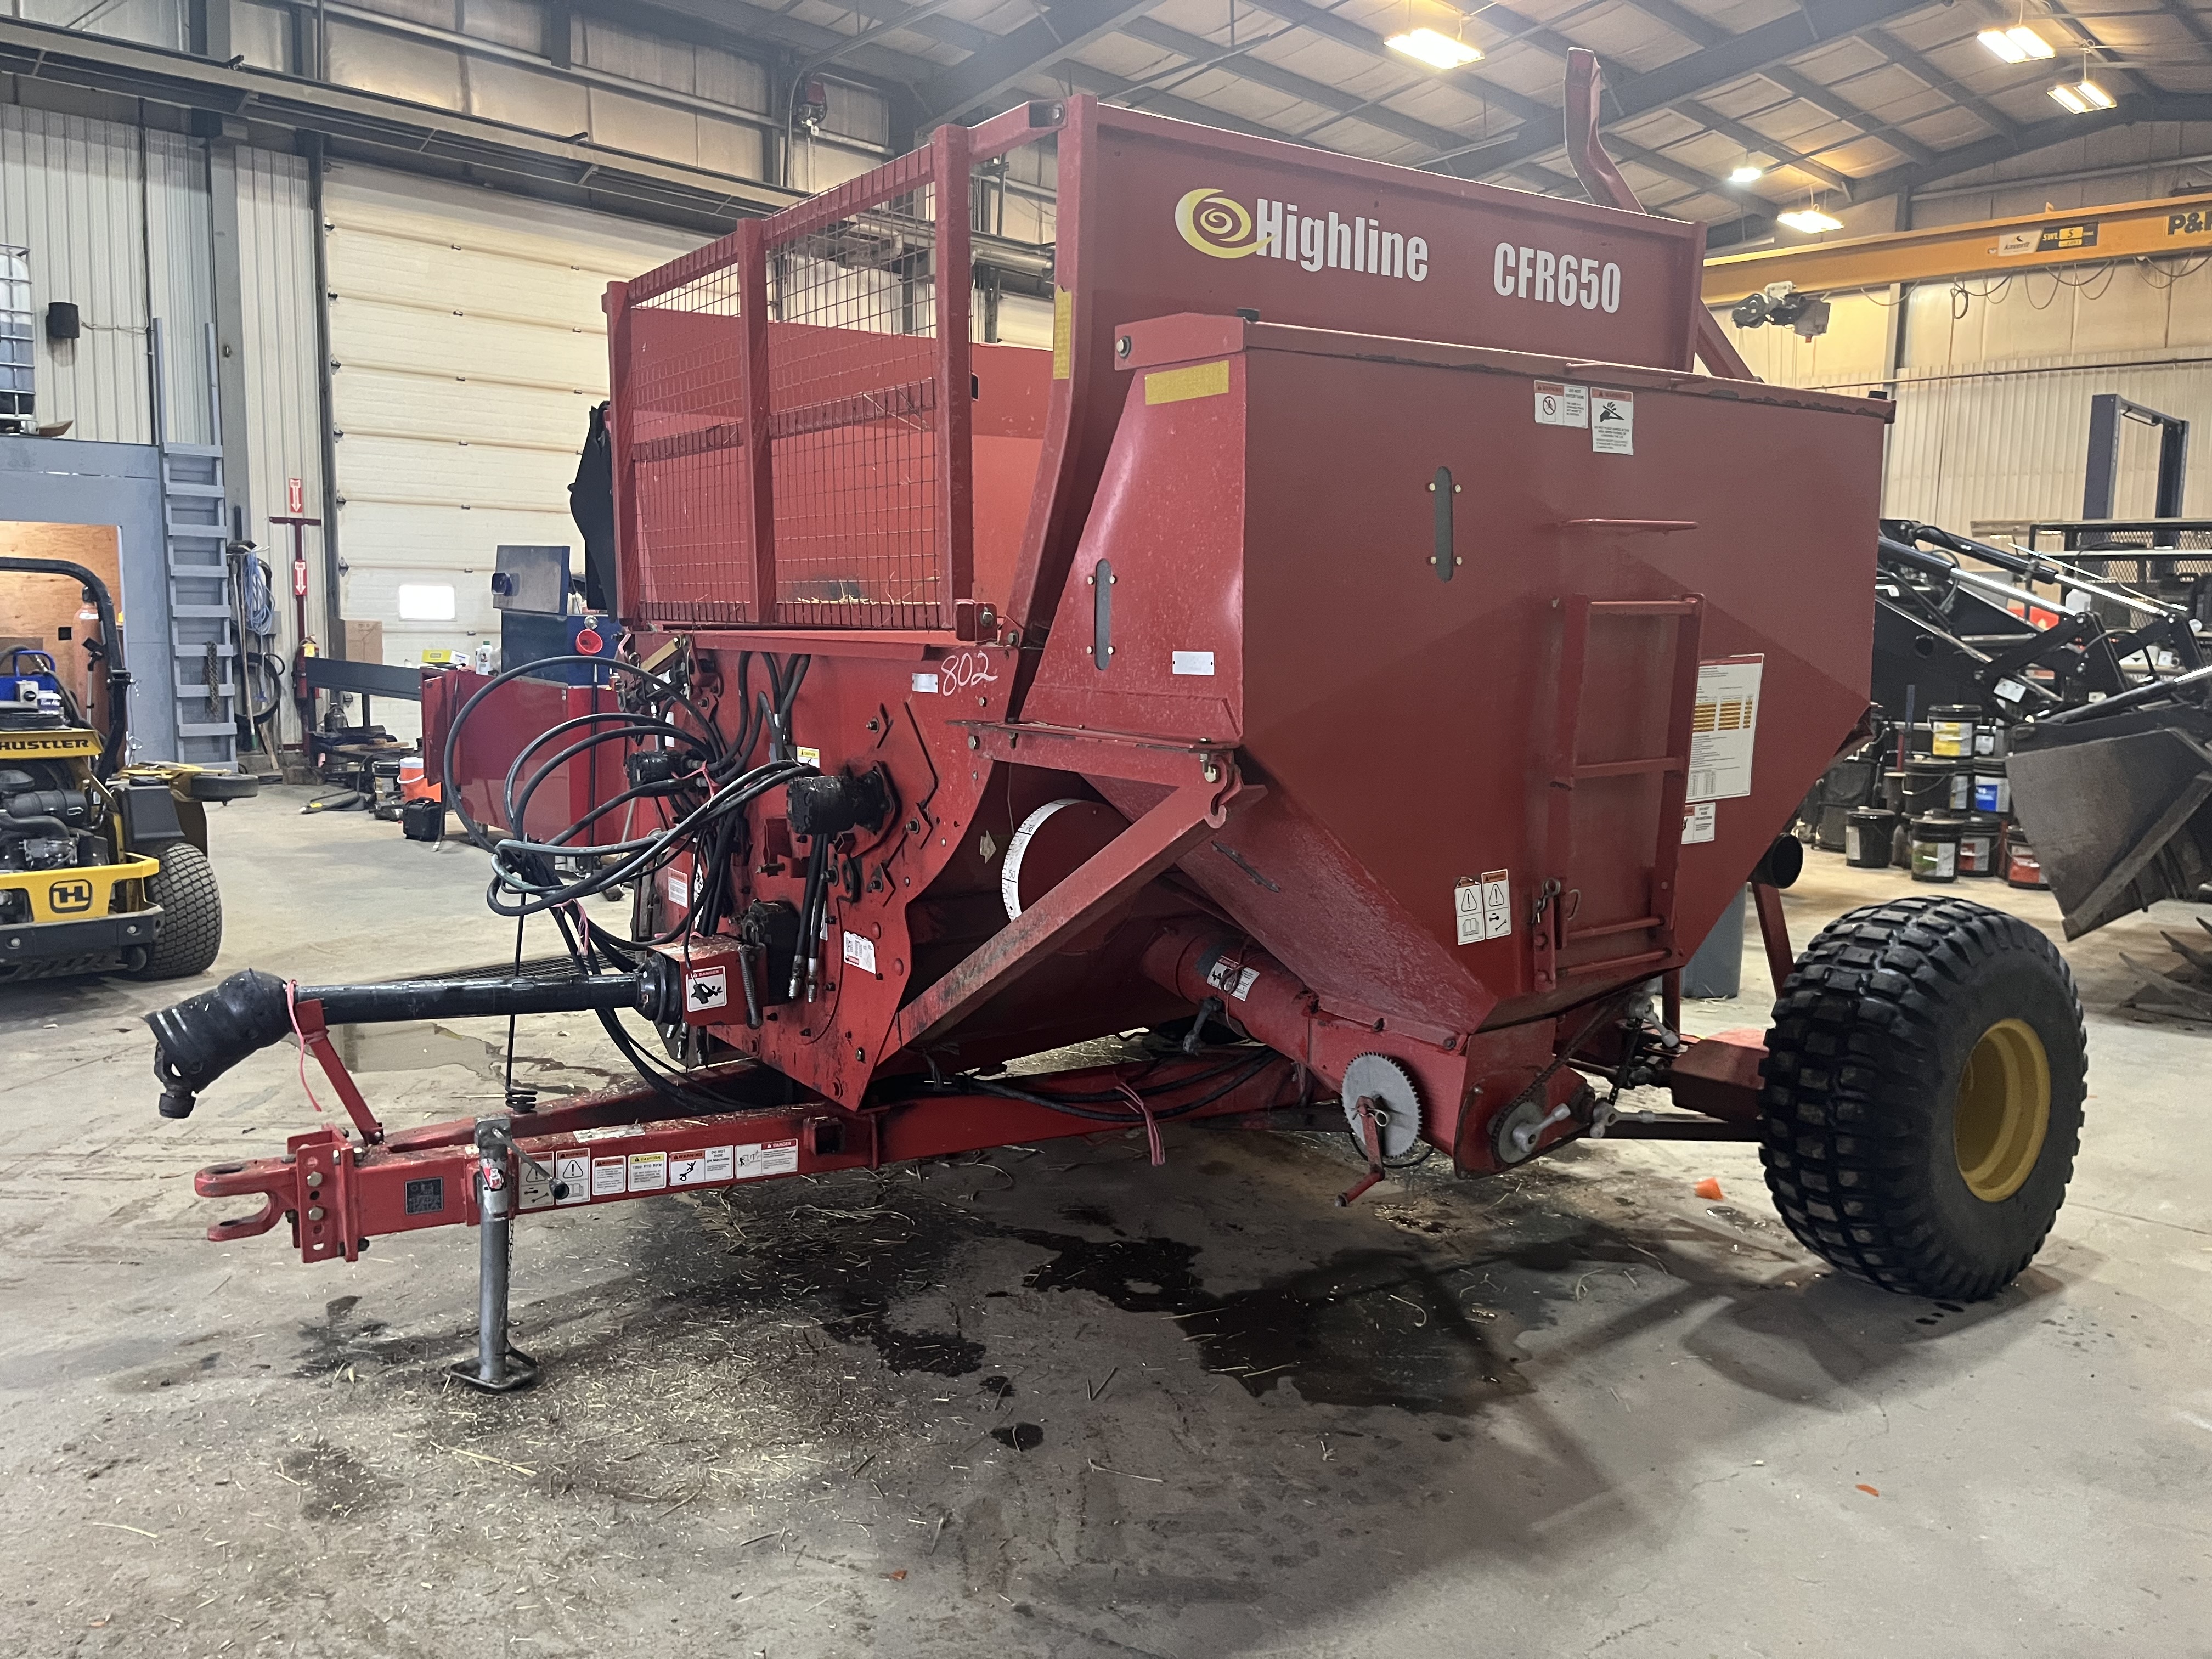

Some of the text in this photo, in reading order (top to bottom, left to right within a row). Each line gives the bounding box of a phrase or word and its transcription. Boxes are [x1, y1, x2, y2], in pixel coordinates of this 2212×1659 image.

[1256, 198, 1428, 282] Highline
[2067, 229, 2074, 238] 5
[1494, 242, 1621, 313] CFR650
[941, 650, 998, 696] 802
[0, 739, 89, 751] HUSTLER
